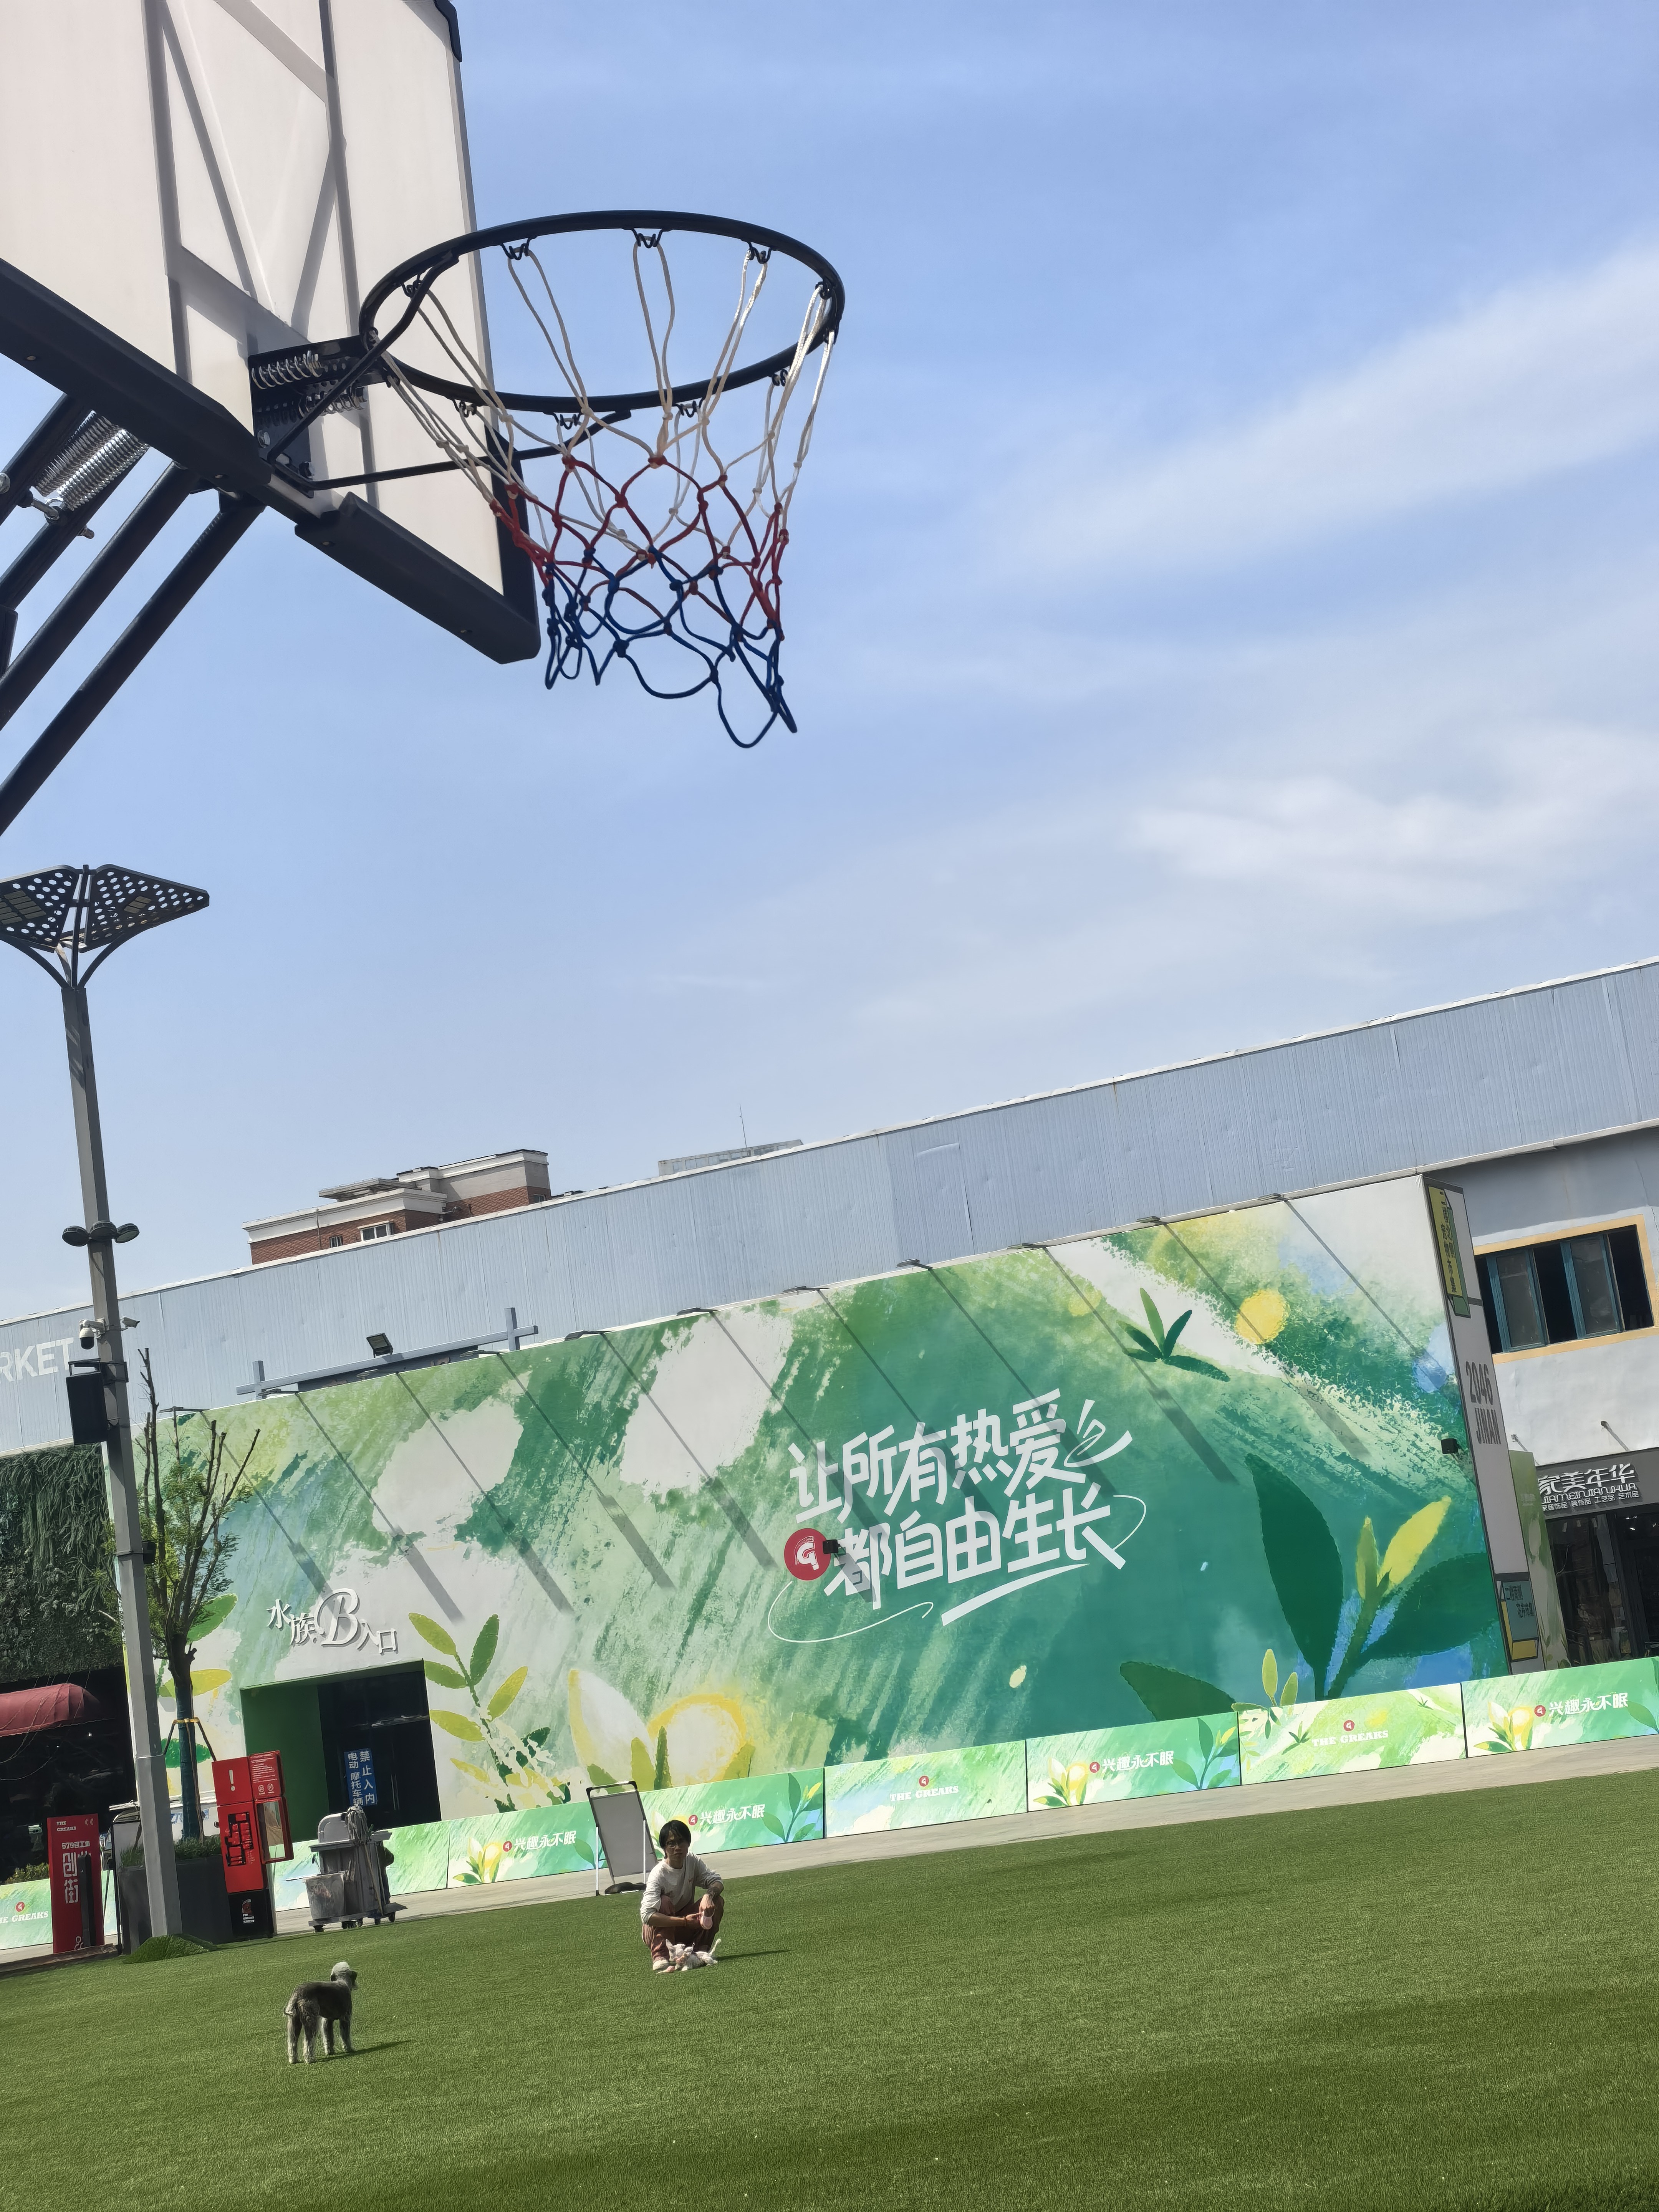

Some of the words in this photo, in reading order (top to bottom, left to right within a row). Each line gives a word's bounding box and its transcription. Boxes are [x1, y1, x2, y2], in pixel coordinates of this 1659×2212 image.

[1465, 1361, 1493, 1405] 2046
[787, 1388, 1086, 1524] 让所有热爱
[1537, 1463, 1635, 1495] 家美年华
[824, 1482, 1126, 1611] 都自由生长
[1549, 1692, 1628, 1716] 兴趣永不眠
[1311, 1737, 1336, 1747] THE
[1340, 1730, 1389, 1743] GREAKS
[1102, 1750, 1174, 1773] 兴趣永不眠
[359, 1750, 375, 1805] 禁止入内
[889, 1791, 912, 1802] THE
[915, 1785, 959, 1798] GREAKS
[700, 1804, 765, 1825] 兴趣永不眠
[514, 1830, 576, 1851] 兴趣永不眠
[12, 1911, 48, 1922] GREAKS
